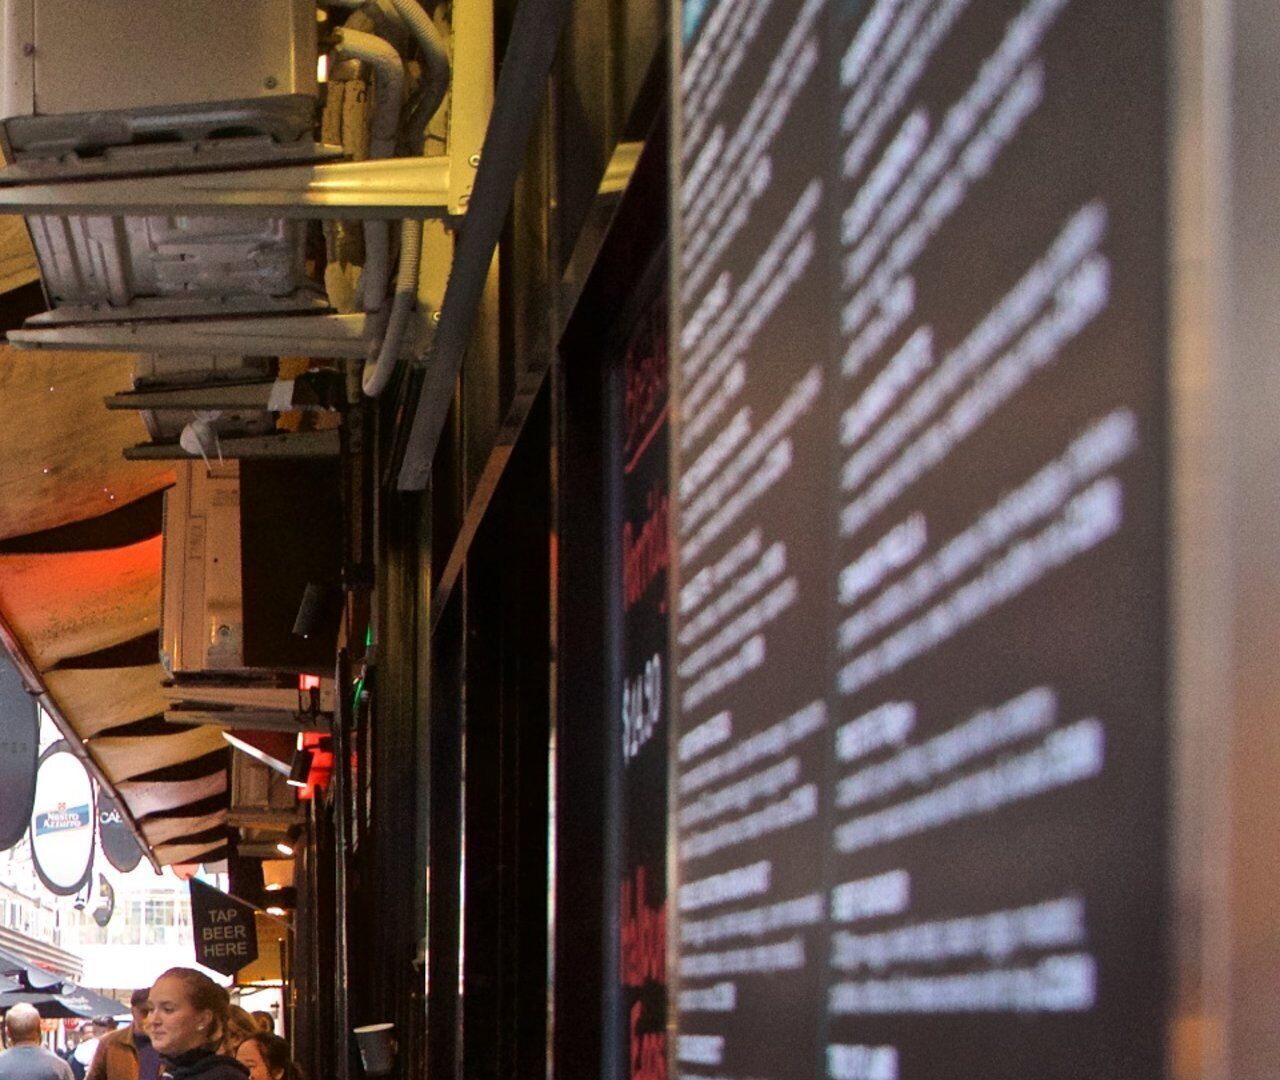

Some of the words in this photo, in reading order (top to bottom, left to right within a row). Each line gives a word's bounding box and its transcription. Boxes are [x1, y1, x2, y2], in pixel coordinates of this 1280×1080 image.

[208, 909, 238, 922] TAP
[202, 925, 247, 941] BEER
[203, 942, 248, 958] HERE
